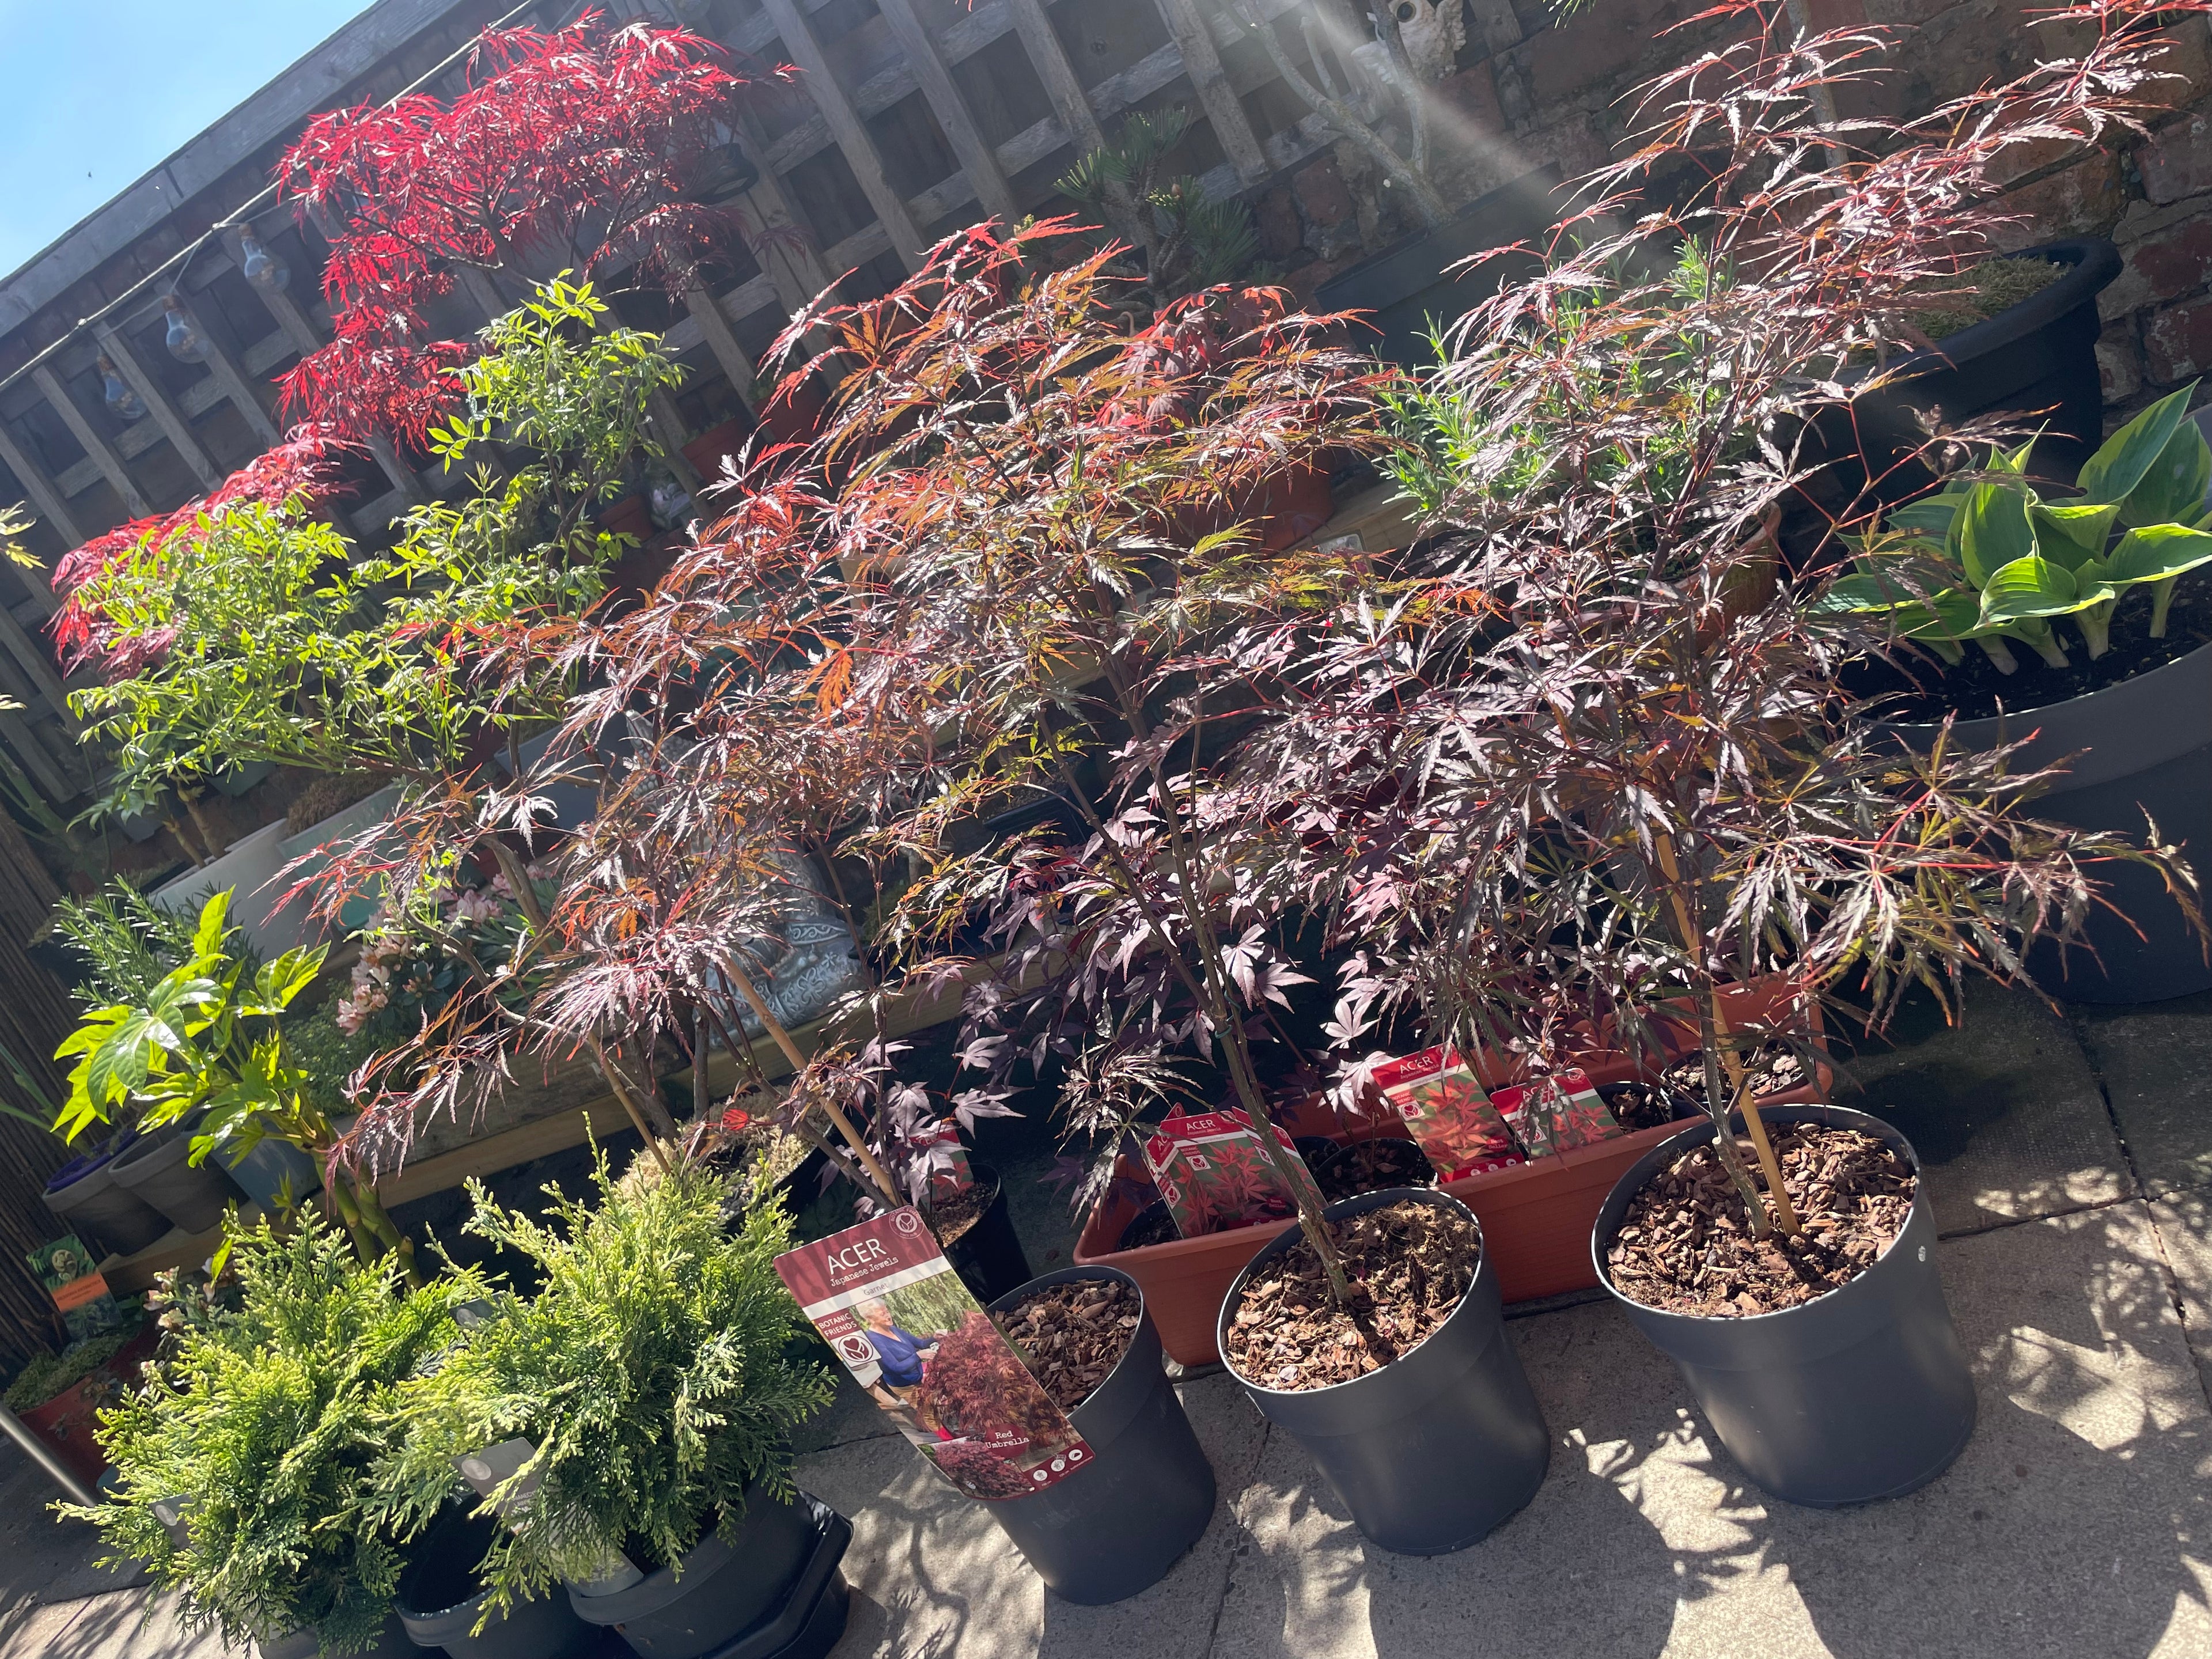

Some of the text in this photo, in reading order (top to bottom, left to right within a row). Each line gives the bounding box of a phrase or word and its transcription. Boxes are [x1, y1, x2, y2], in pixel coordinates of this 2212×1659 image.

[1400, 1056, 1433, 1074] ACER
[1187, 1119, 1216, 1131] ACER
[827, 1238, 887, 1275] ACER
[830, 1256, 899, 1287] Japanese Jewels
[863, 1283, 889, 1296] Garnet
[818, 1313, 851, 1329] BOTANIC
[824, 1321, 857, 1336] FRIENDS
[995, 1430, 1014, 1440] Red
[985, 1437, 1030, 1449] Umbrella
